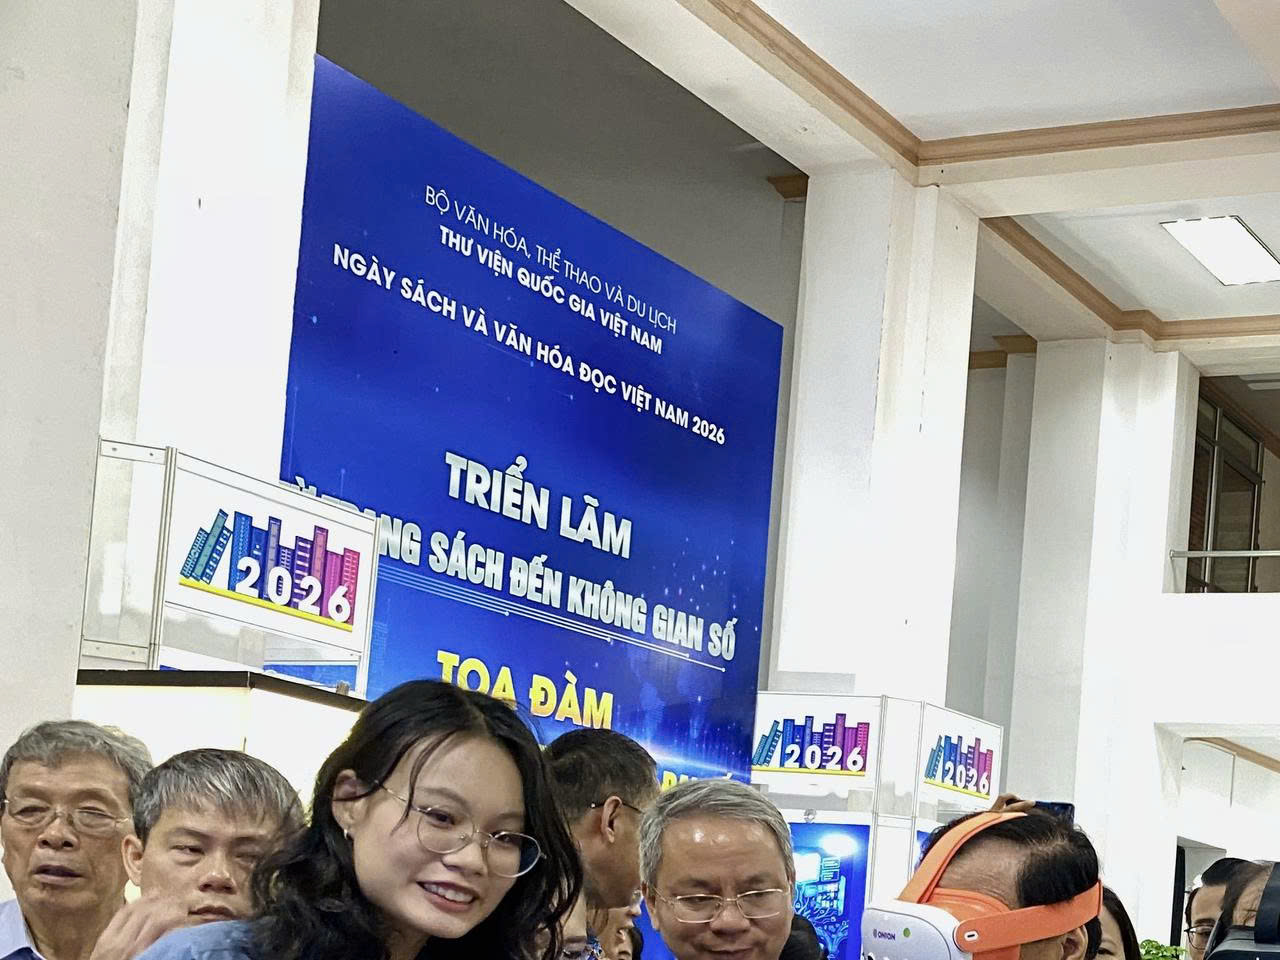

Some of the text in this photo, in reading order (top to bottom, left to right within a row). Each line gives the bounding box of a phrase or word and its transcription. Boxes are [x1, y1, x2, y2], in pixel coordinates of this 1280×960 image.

[425, 185, 677, 335] BỘ VĂN HÓA, THỂ THAO VÀ DU LỊCH
[439, 224, 663, 355] THƯ VIỆN QUỐC GIA VIỆT NAM
[333, 243, 726, 445] NGÀY SÁCH VÀ VĂN HÓA ĐỌC VIỆT NAM 2026
[445, 451, 550, 530] TRIỂN
[559, 494, 632, 559] LÃM
[235, 556, 351, 623] 2026
[428, 530, 505, 591] SÁCH
[509, 554, 563, 609] ĐẾN
[567, 575, 648, 635] KHÔNG
[652, 604, 704, 652] GIAN
[707, 617, 738, 661] SỐ
[529, 670, 614, 730] ĐÀM
[784, 743, 865, 773] 2026
[944, 761, 989, 795] 2026
